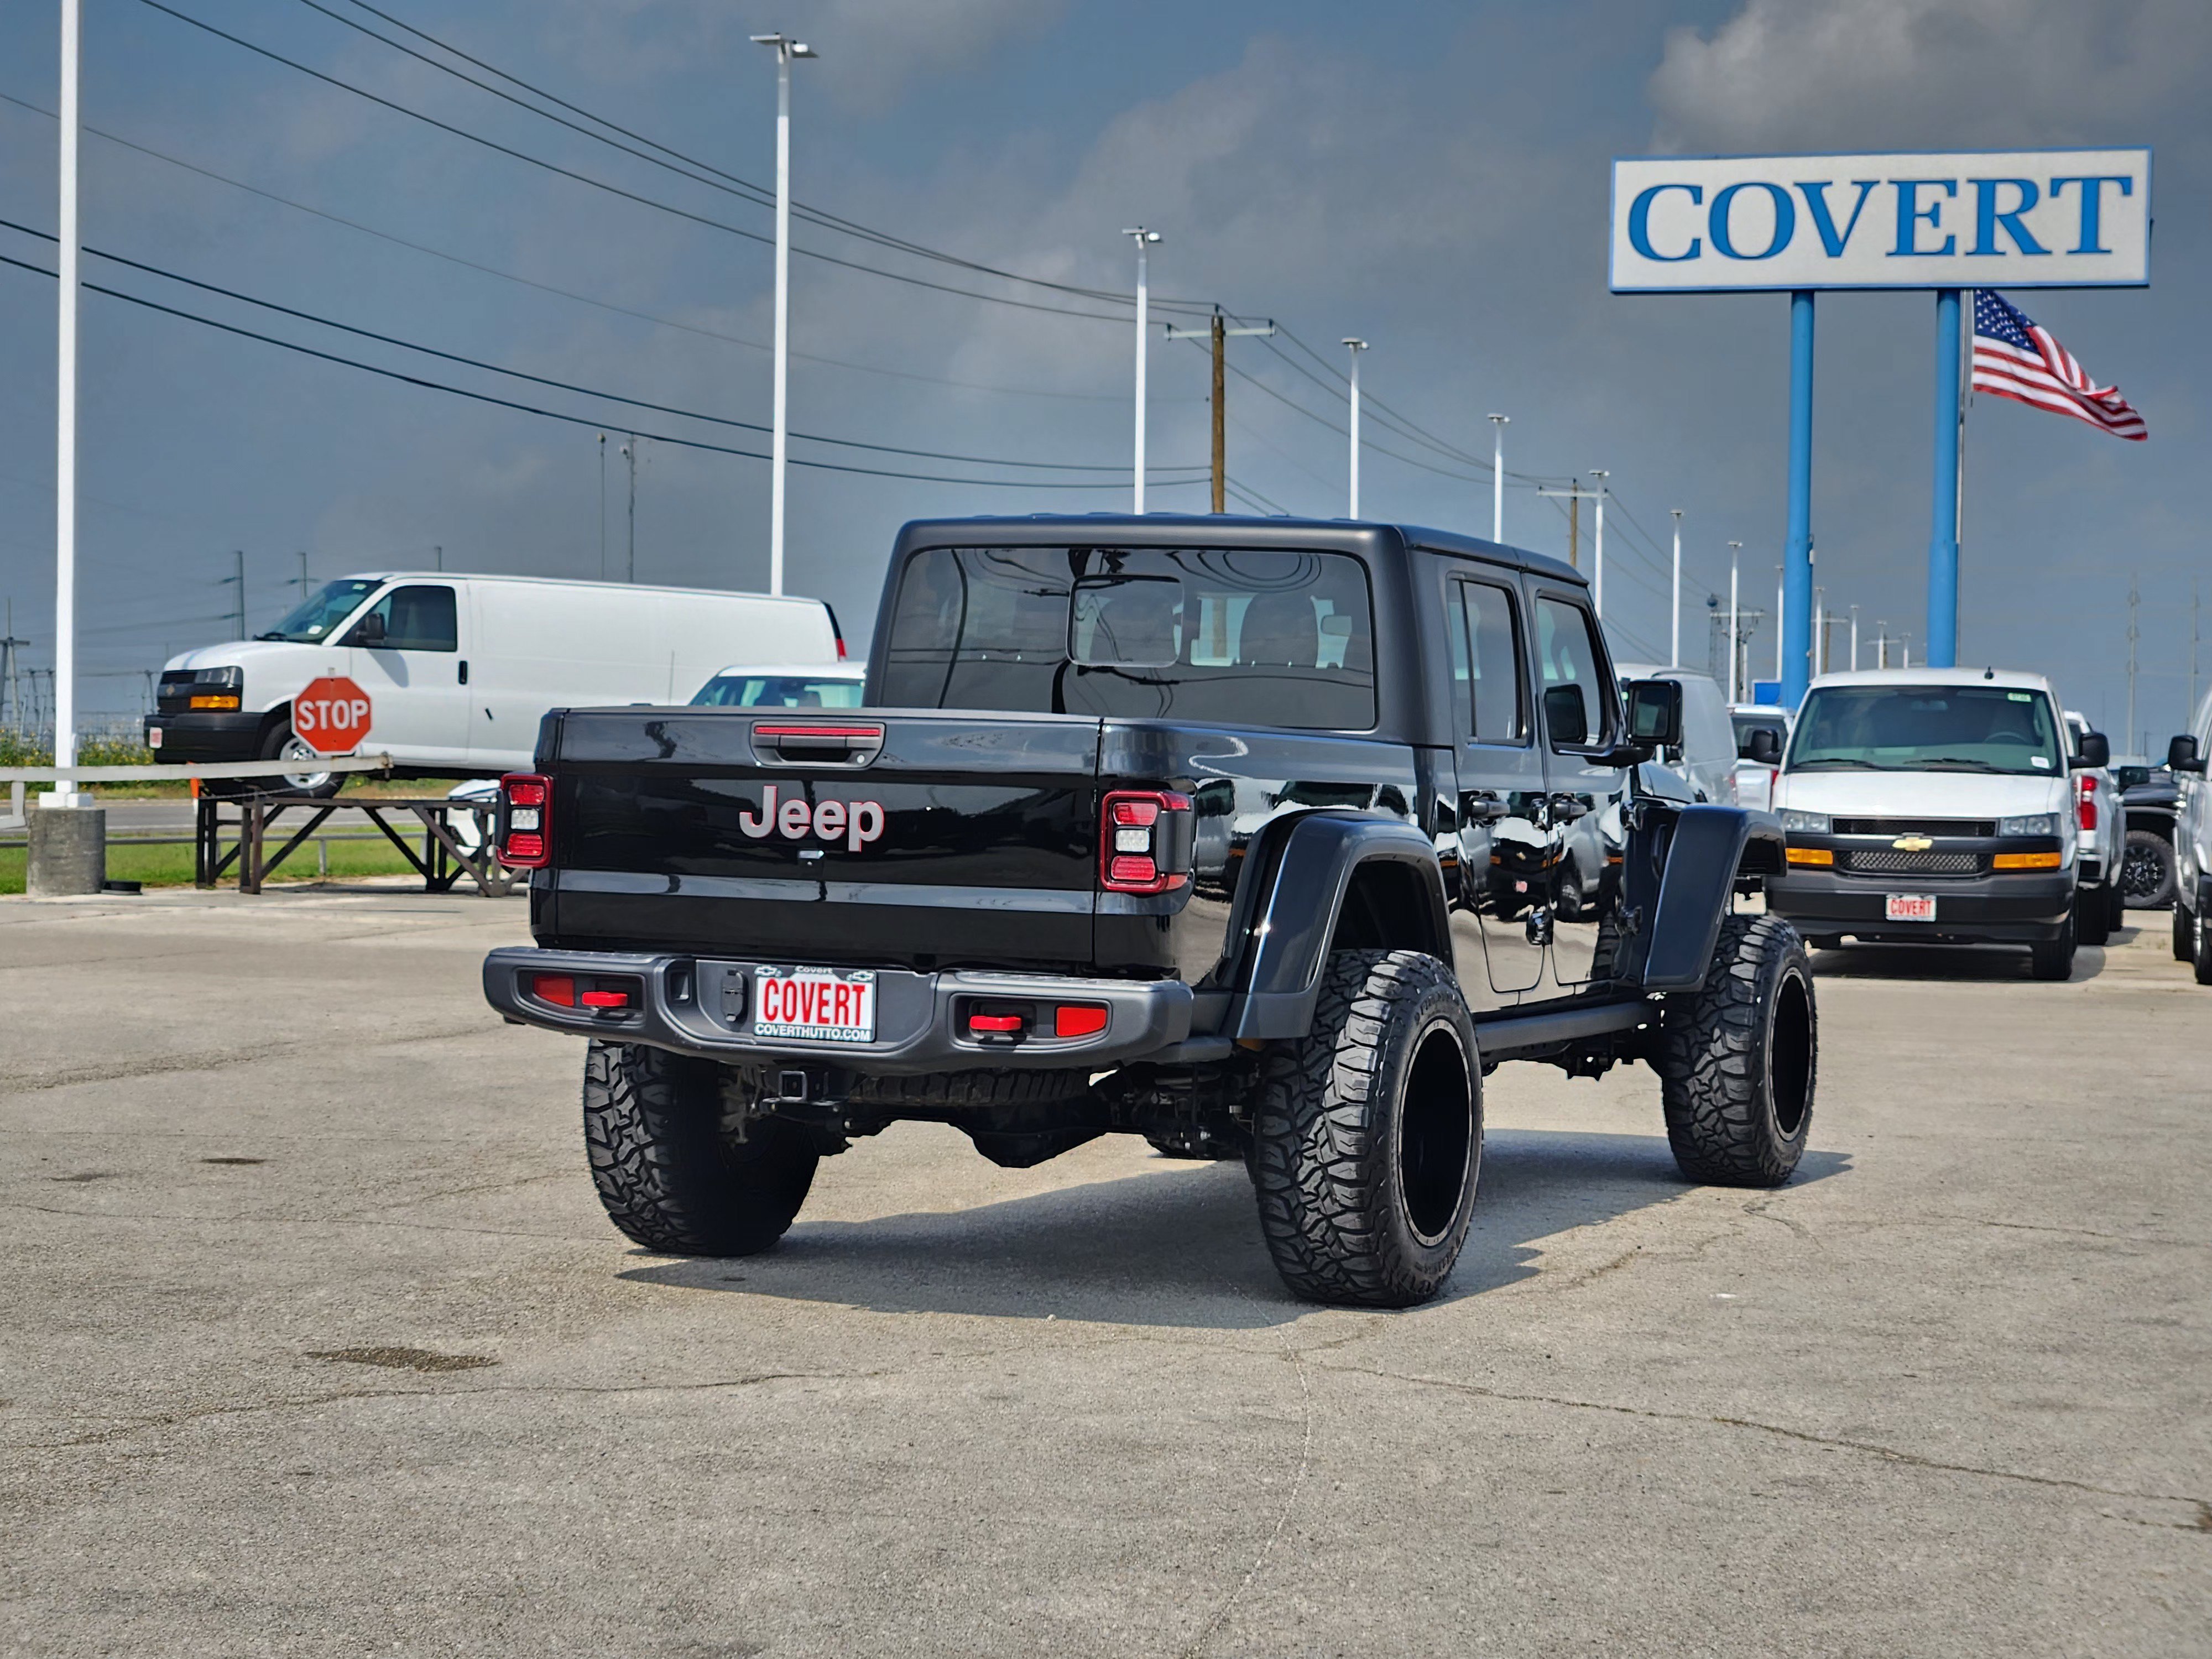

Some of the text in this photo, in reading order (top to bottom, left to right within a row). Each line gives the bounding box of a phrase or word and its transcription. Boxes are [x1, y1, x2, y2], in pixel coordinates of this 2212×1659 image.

[1627, 176, 2133, 263] COVERT
[298, 699, 369, 731] STOP
[739, 785, 885, 853] Jeep
[1891, 899, 1931, 916] COVERT
[795, 966, 833, 974] Covert
[764, 978, 865, 1026] COVERT
[755, 1023, 870, 1041] COVERTHUTTO.COM
